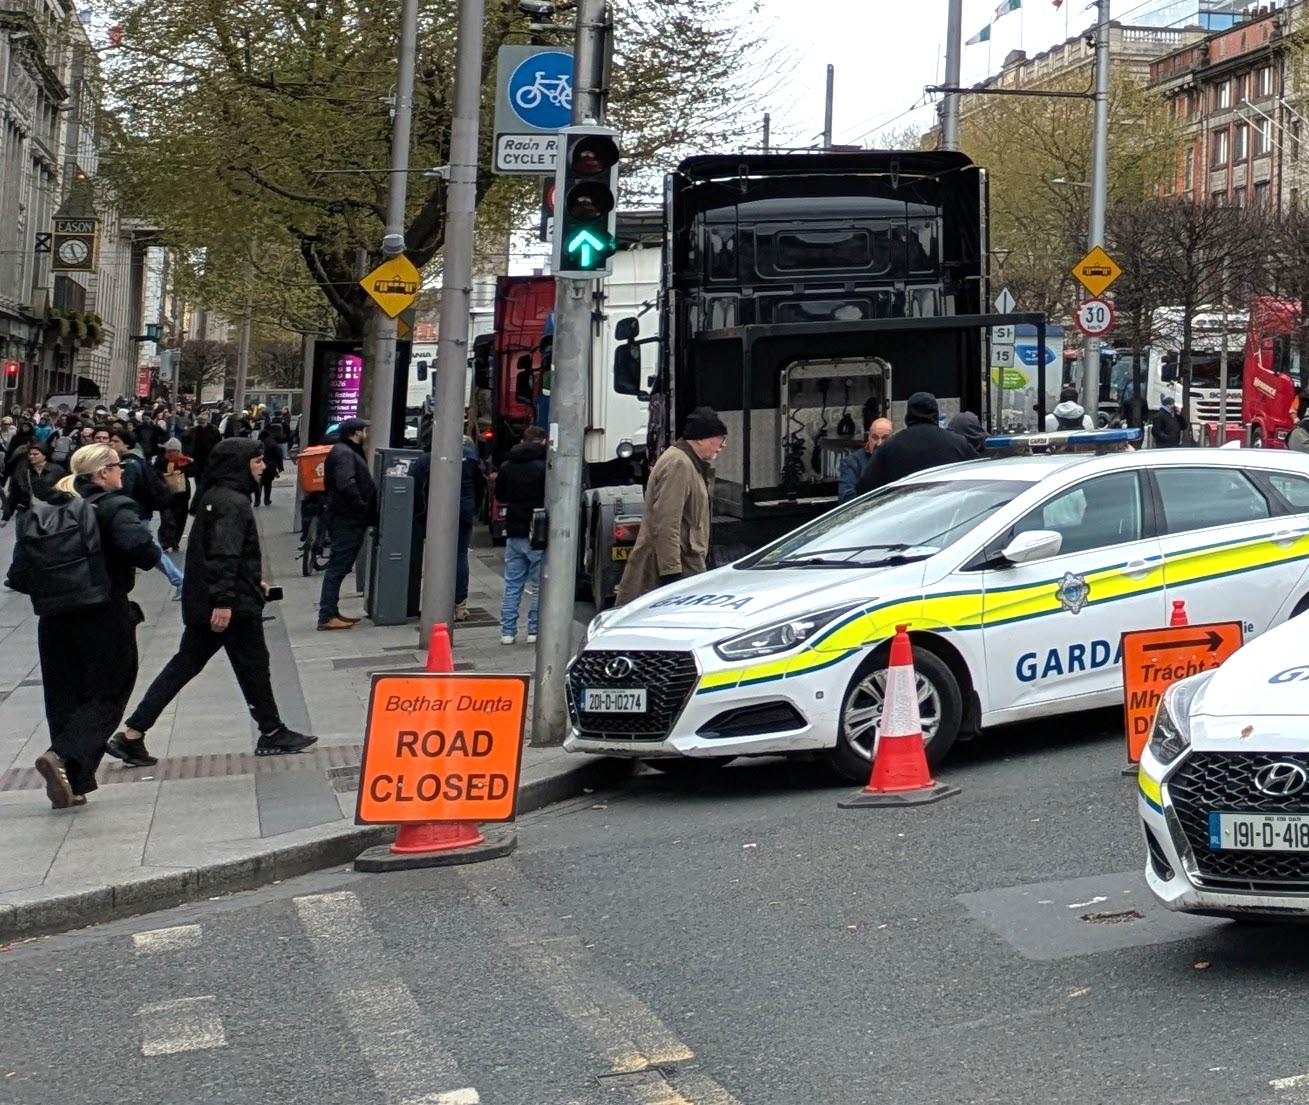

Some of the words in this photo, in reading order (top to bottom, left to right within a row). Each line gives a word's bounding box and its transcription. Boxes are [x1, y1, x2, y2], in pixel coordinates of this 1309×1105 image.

[545, 140, 558, 151] R
[503, 154, 545, 165] CYCLE
[549, 154, 557, 165] T
[58, 222, 92, 233] EASON
[1085, 307, 1105, 323] 30
[996, 350, 1010, 361] 15
[650, 594, 754, 610] GARDA
[385, 695, 453, 713] Bothar
[456, 695, 513, 713] Dunta
[589, 693, 642, 711] 201-D-10274
[396, 730, 493, 758] ROAD
[370, 773, 509, 803] CLOSED
